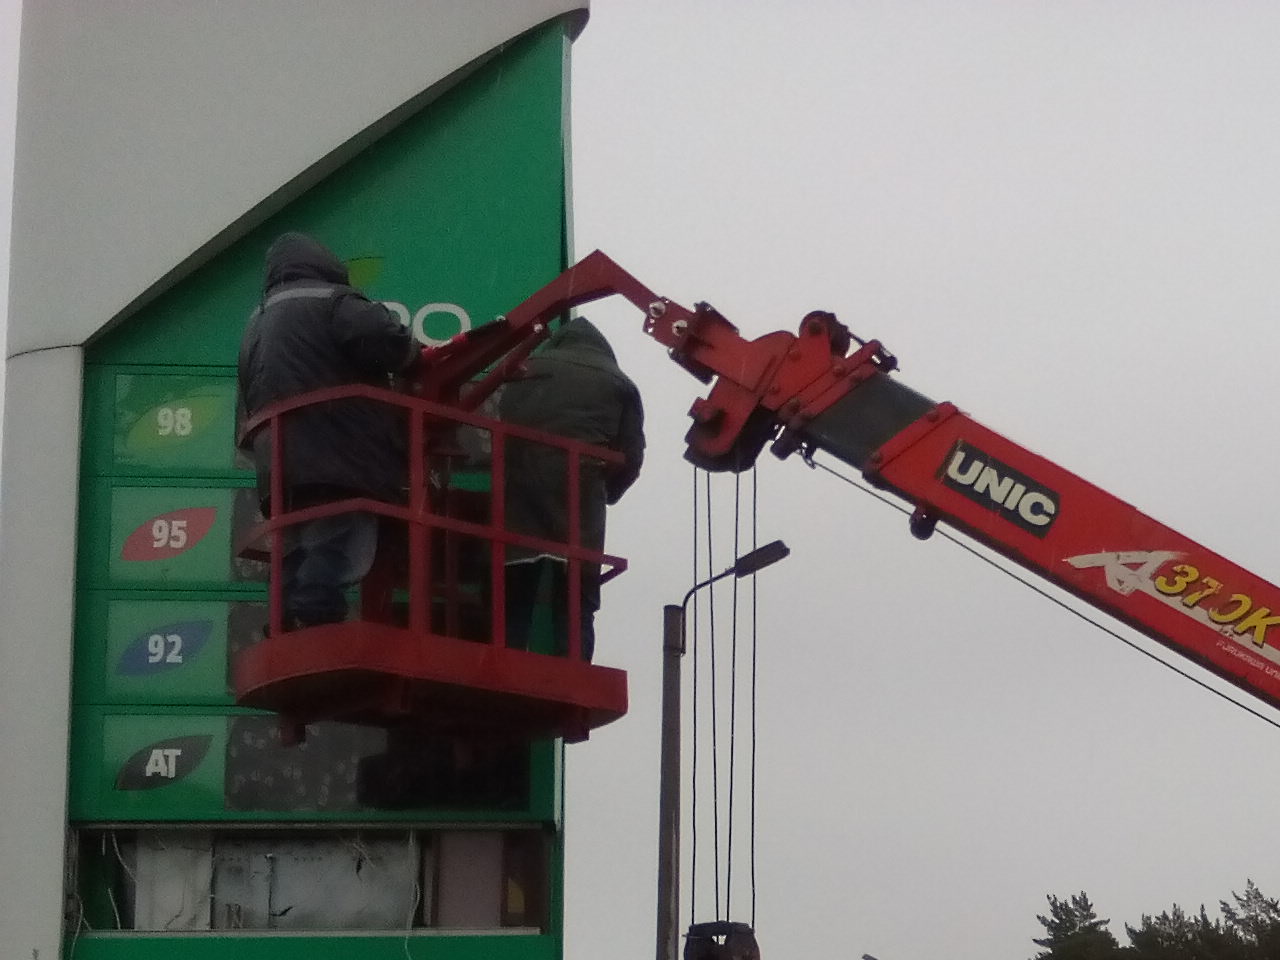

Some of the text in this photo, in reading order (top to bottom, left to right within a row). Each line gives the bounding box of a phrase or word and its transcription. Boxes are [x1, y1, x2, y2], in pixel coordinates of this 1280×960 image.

[156, 408, 193, 437] 98
[947, 451, 1055, 526] UNIC
[151, 520, 188, 549] 95
[147, 634, 184, 664] 92
